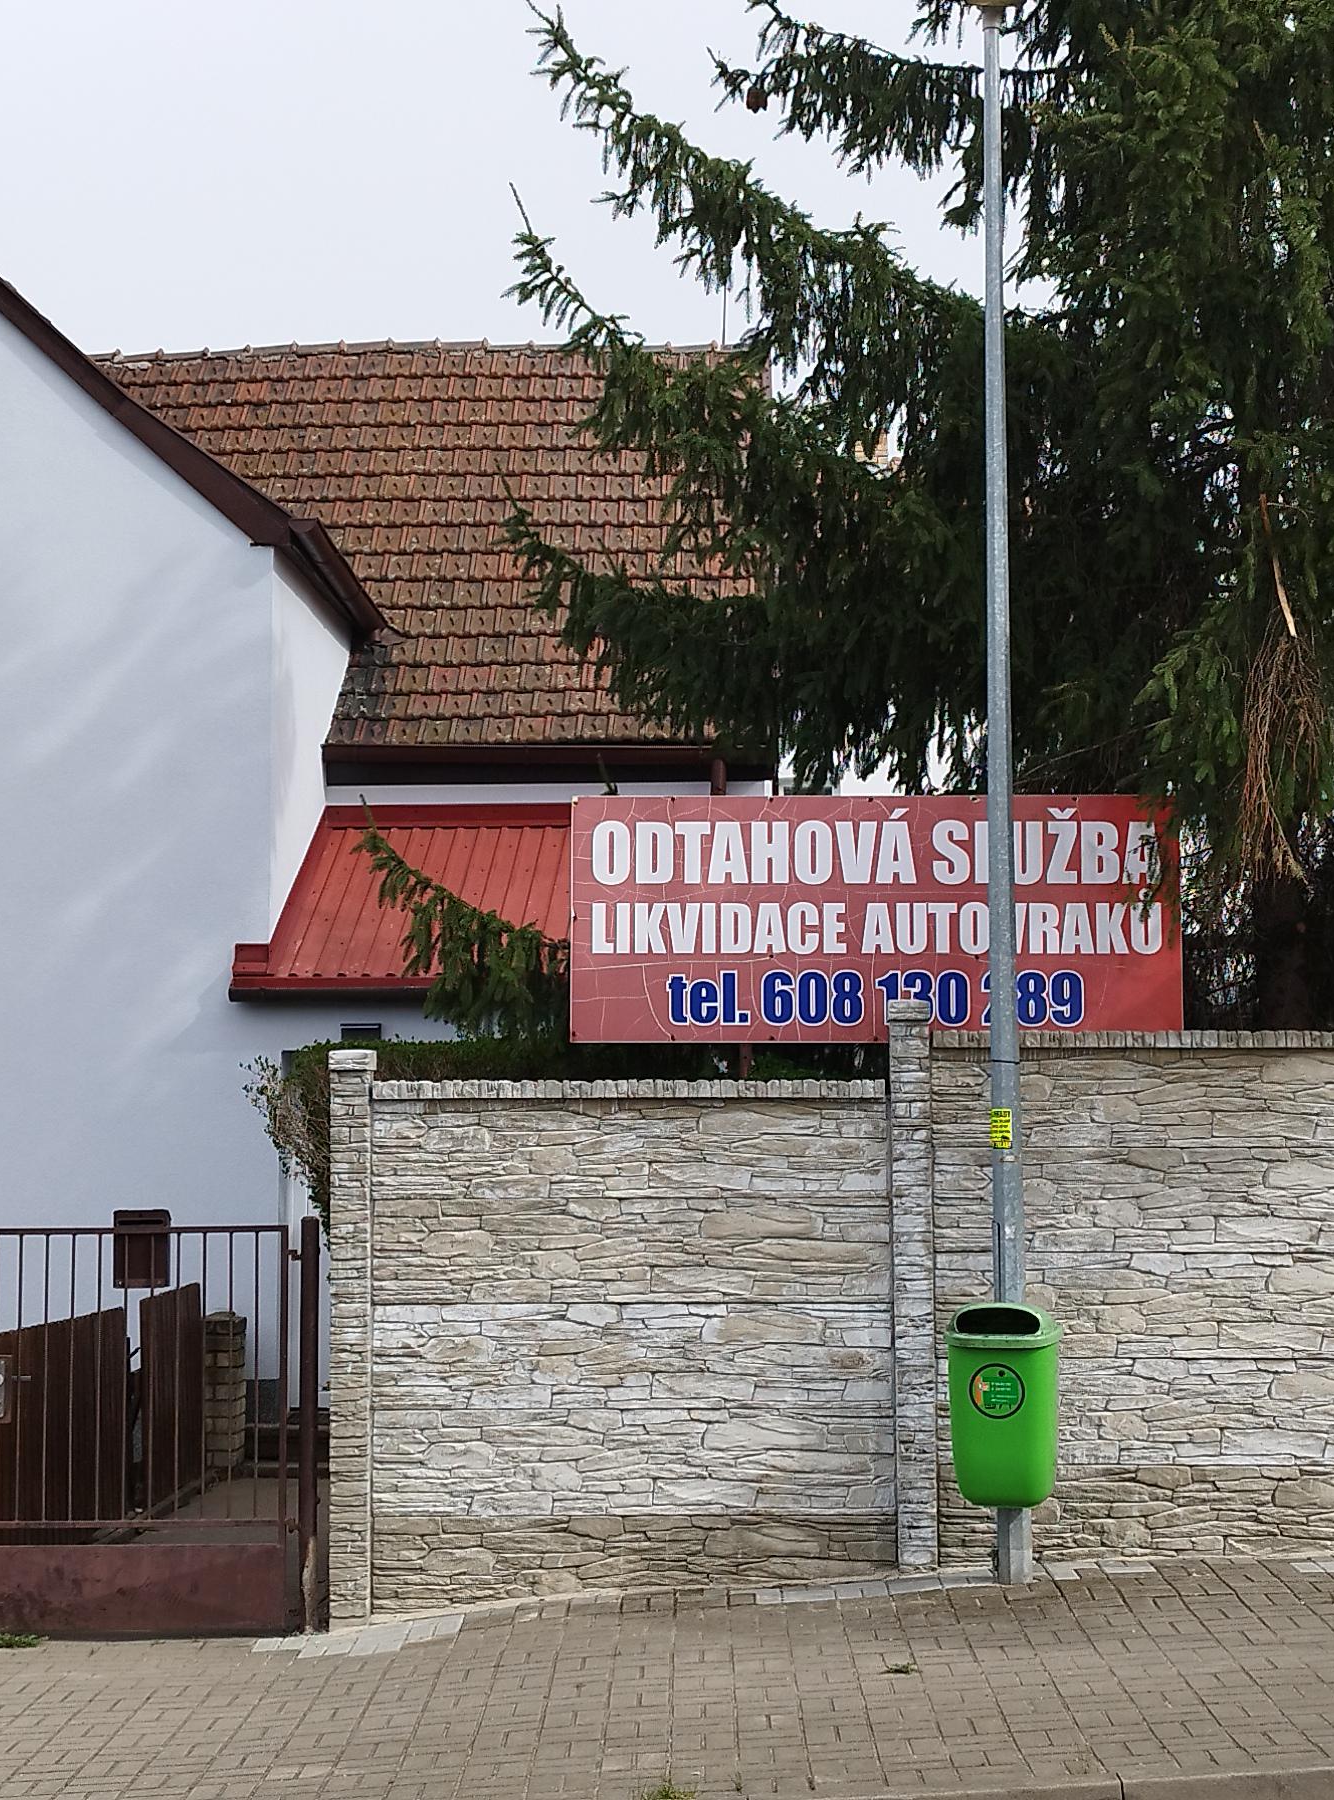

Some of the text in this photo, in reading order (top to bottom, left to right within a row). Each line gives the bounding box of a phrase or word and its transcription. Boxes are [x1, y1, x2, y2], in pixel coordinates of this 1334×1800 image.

[591, 808, 917, 886] ODTAHOVÁ
[591, 887, 1163, 955] LIKVIDACE AUTORAKŮ
[667, 973, 751, 1027] tel.
[761, 969, 864, 1027] 608
